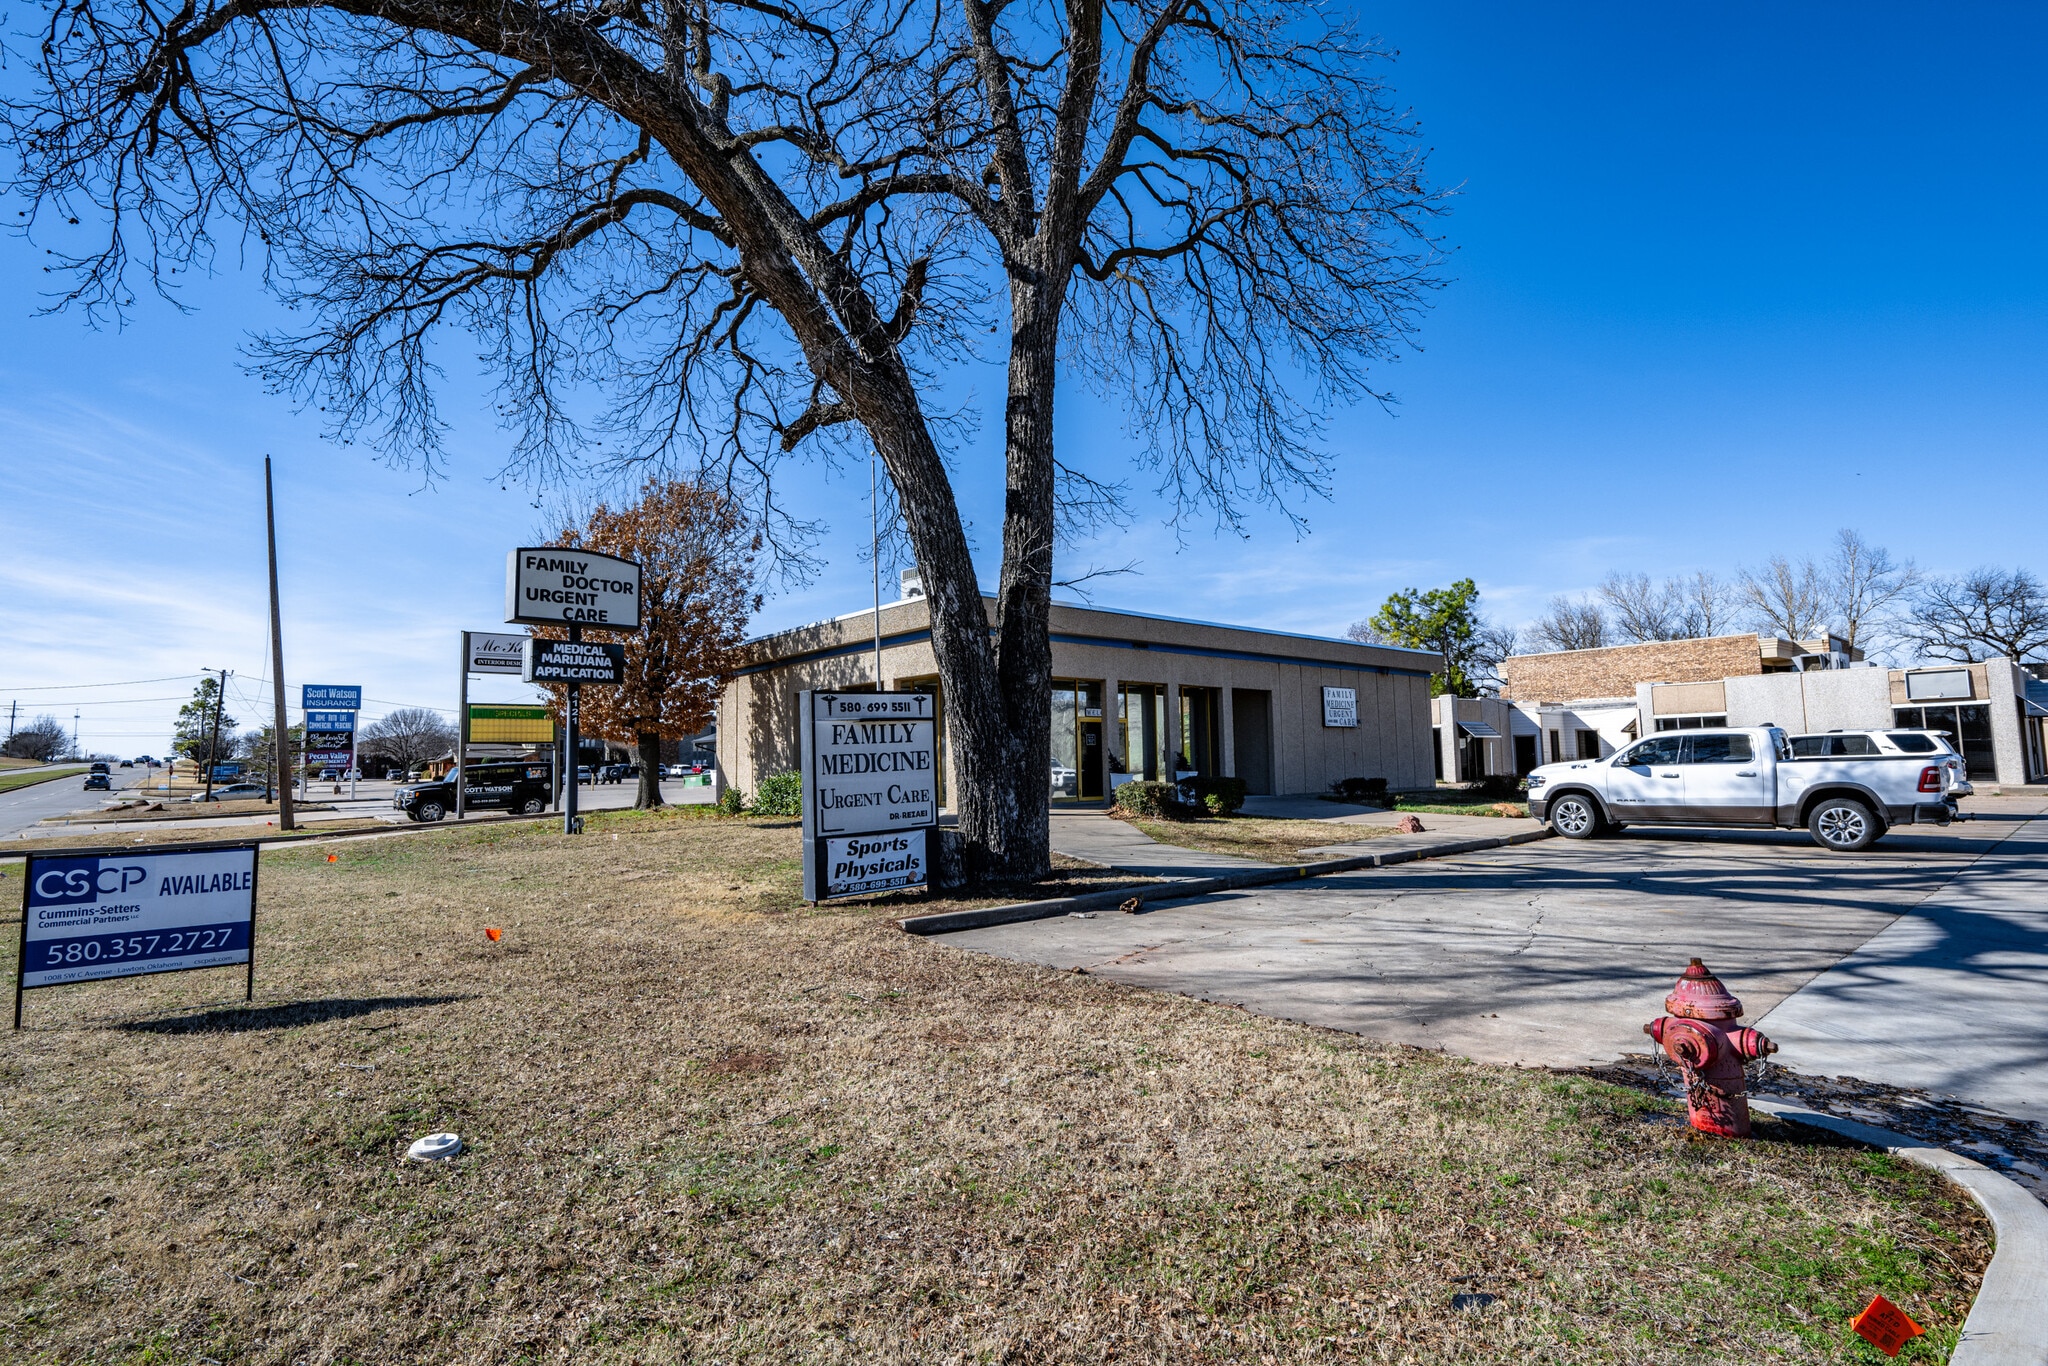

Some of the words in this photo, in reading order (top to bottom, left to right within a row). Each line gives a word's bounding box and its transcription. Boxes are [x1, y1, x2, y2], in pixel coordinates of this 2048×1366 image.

[526, 556, 588, 575] FAMILY
[562, 575, 634, 595] DOCTOR
[526, 587, 598, 606] URGENT
[562, 607, 608, 623] CARE
[553, 643, 606, 657] MEDICAL
[541, 653, 612, 668] MARIJUANA
[535, 666, 614, 680] APPLICATION
[307, 688, 327, 699] Scott
[328, 688, 357, 699] Watson
[1327, 690, 1352, 698] FAMILY
[306, 699, 357, 707] INSURANCE
[891, 701, 911, 713] 5511
[1326, 700, 1354, 708] MEDICINE
[1328, 710, 1353, 718] URGENT
[1339, 718, 1356, 726] CARE
[831, 723, 917, 746] FAMILY
[308, 752, 329, 760] Pecan
[329, 752, 350, 761] Valley
[821, 750, 930, 776] MEDICINE
[484, 785, 513, 793] WATSON
[819, 788, 883, 810] URGENT
[887, 784, 930, 805] CARE
[846, 837, 909, 858] Sports
[834, 854, 920, 881] Physicals
[159, 871, 252, 897] AVAILABLE
[848, 876, 908, 892] 580-699-5511
[38, 904, 141, 920] Cummins-Setters
[38, 917, 91, 929] Commercial
[93, 914, 130, 924] Partners
[46, 928, 233, 965] 580.357.2727
[193, 955, 233, 965] cscpok.com
[43, 974, 63, 982] 1008
[84, 968, 113, 977] Avenue
[147, 961, 183, 971] Oklahoma
